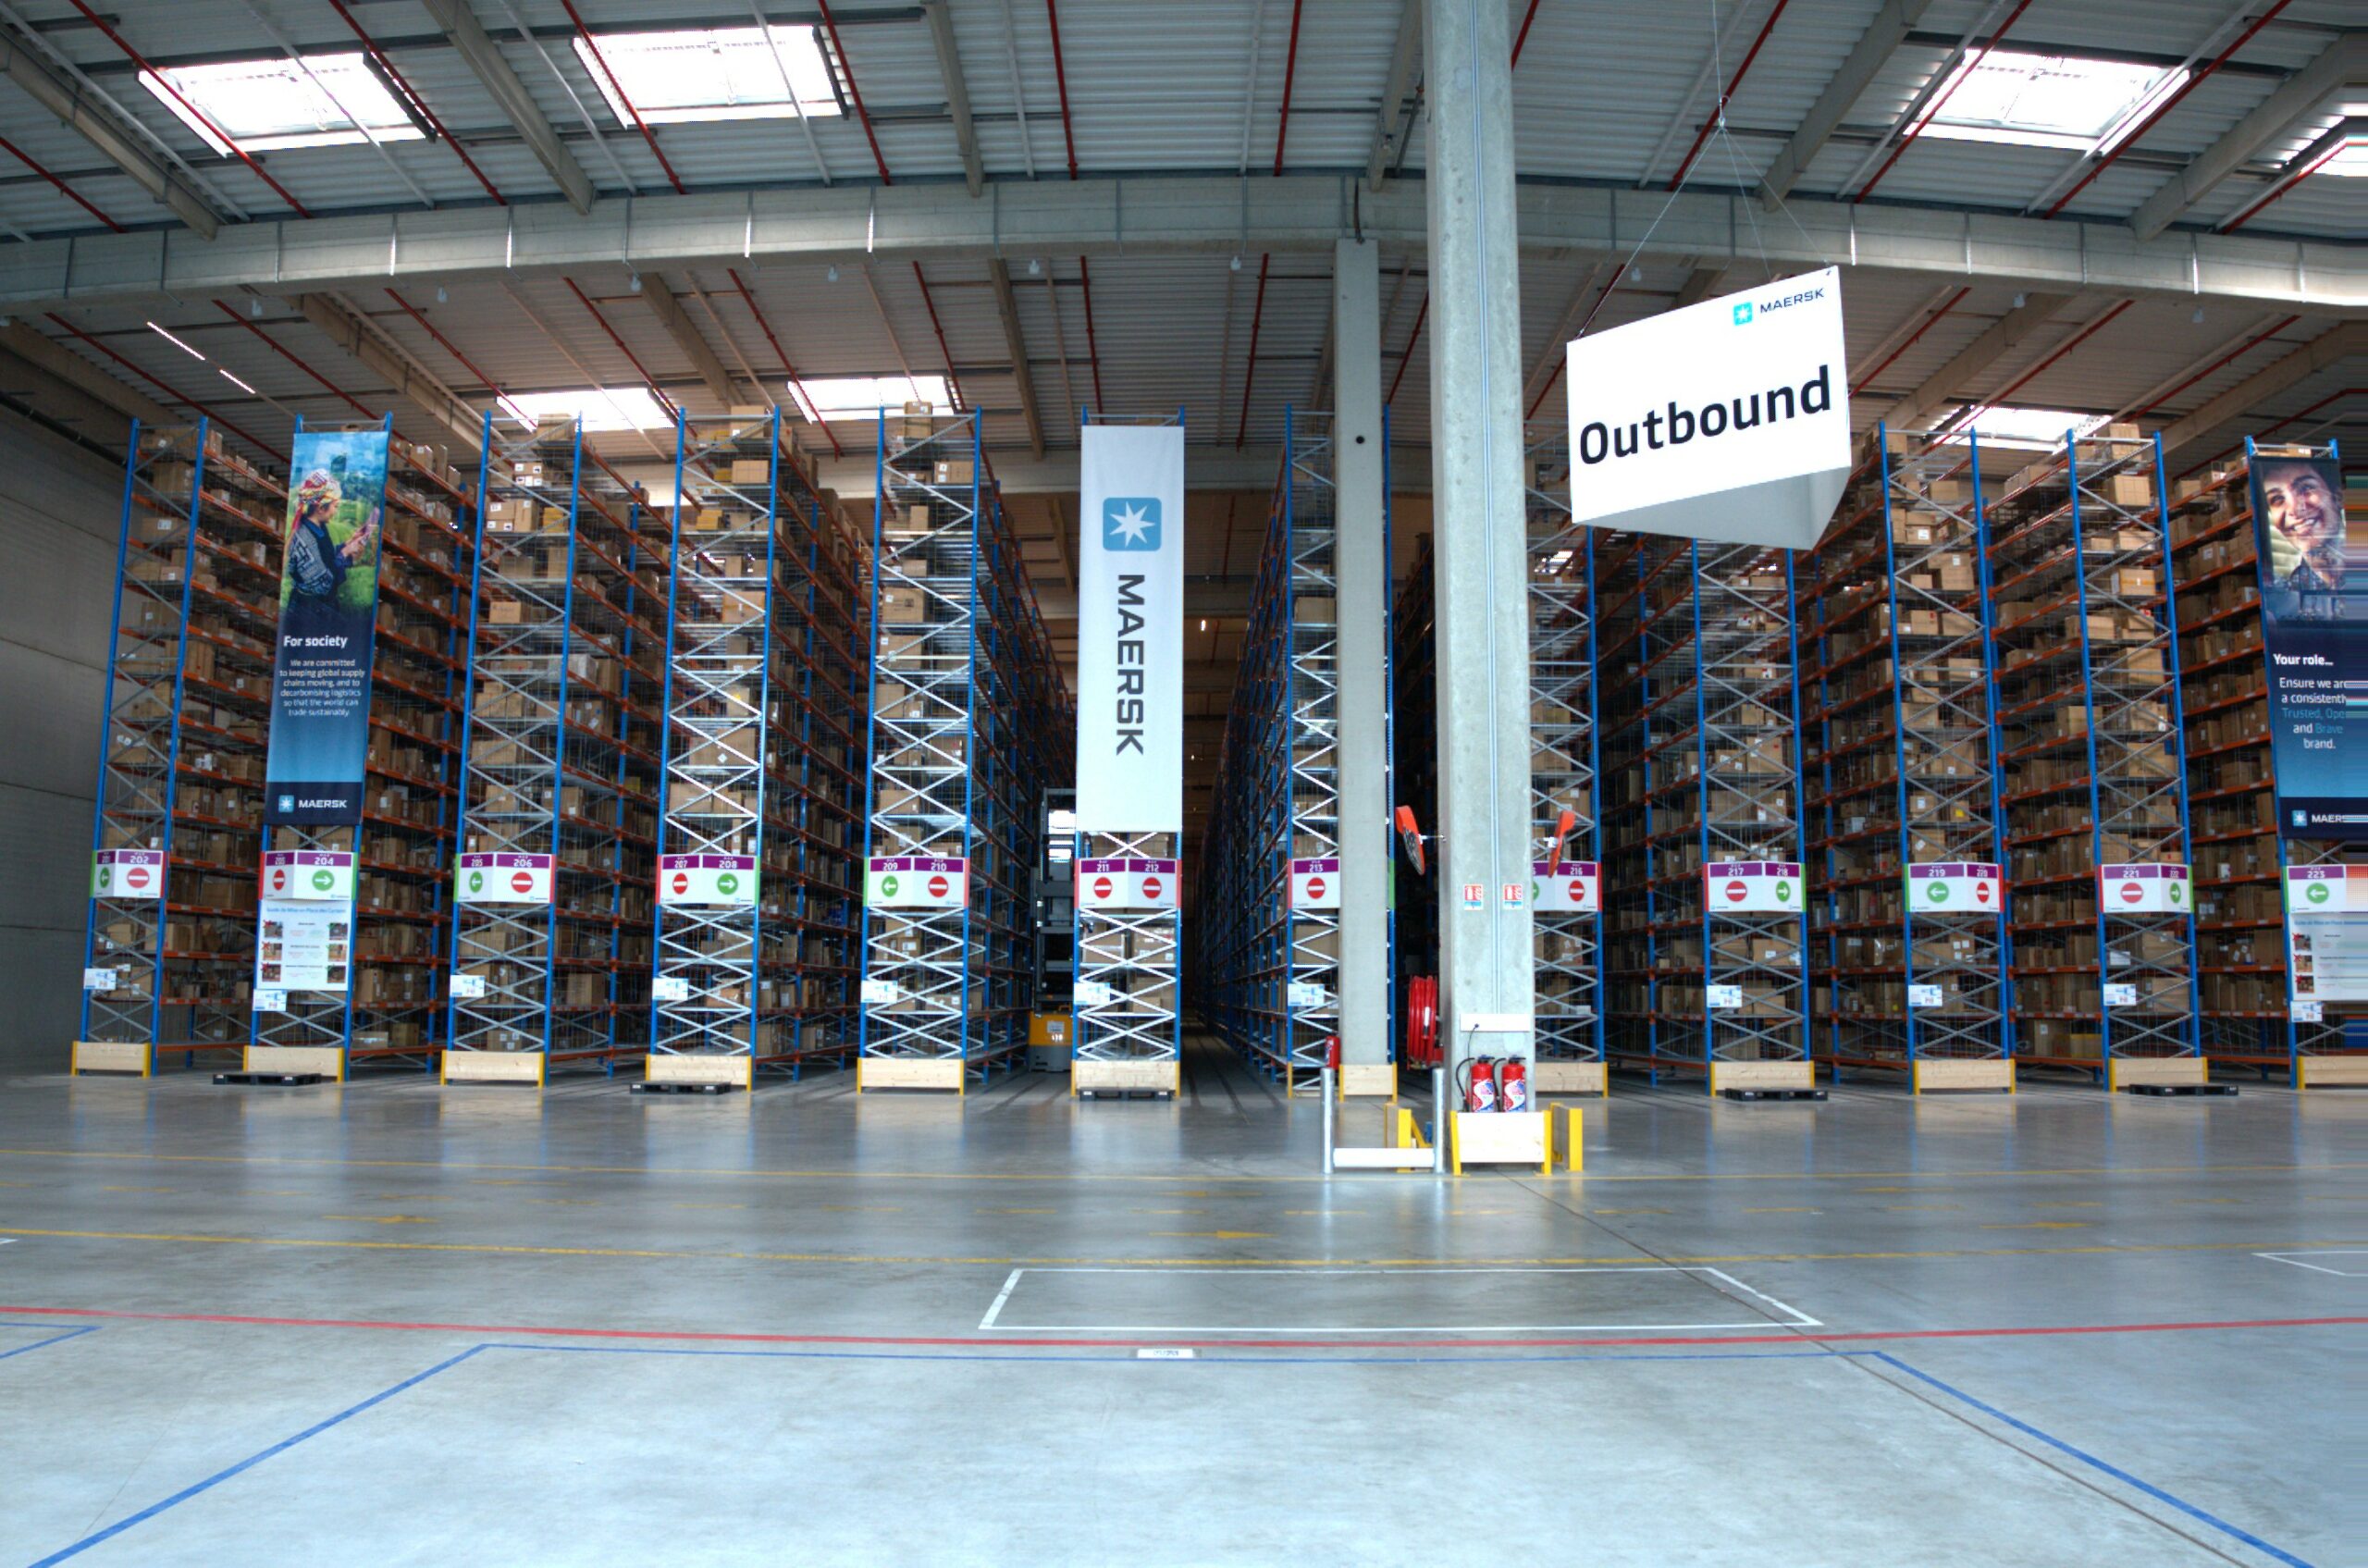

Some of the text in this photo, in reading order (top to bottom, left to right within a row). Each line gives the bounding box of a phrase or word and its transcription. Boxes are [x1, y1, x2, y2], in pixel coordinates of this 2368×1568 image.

[1759, 287, 1825, 314] MAERSK
[1580, 364, 1831, 464] Outbound
[283, 636, 348, 648] For society
[2273, 653, 2300, 665] Your
[1116, 574, 1145, 756] MAERSK
[289, 669, 316, 678] keeping
[317, 669, 340, 678] global
[341, 669, 365, 678] supply
[2279, 677, 2315, 688] Ensure
[2316, 680, 2332, 688] we
[2281, 695, 2288, 703] a
[2281, 708, 2349, 720] Trusted, Ope
[2293, 723, 2344, 734] and Brave
[2303, 738, 2337, 749] brand.
[298, 799, 348, 809] MAERSK
[130, 855, 149, 864] 202
[314, 857, 334, 865] 204
[513, 858, 533, 867] 206
[674, 860, 688, 869] 207
[719, 860, 738, 869] 208
[882, 862, 898, 871] 209
[931, 862, 947, 871] 210
[1096, 864, 1110, 872] 211
[1144, 864, 1159, 872] 212
[1728, 868, 1745, 876] 217
[1928, 869, 1946, 877] 219
[2123, 870, 2140, 879] 221
[2307, 870, 2325, 879] 223
